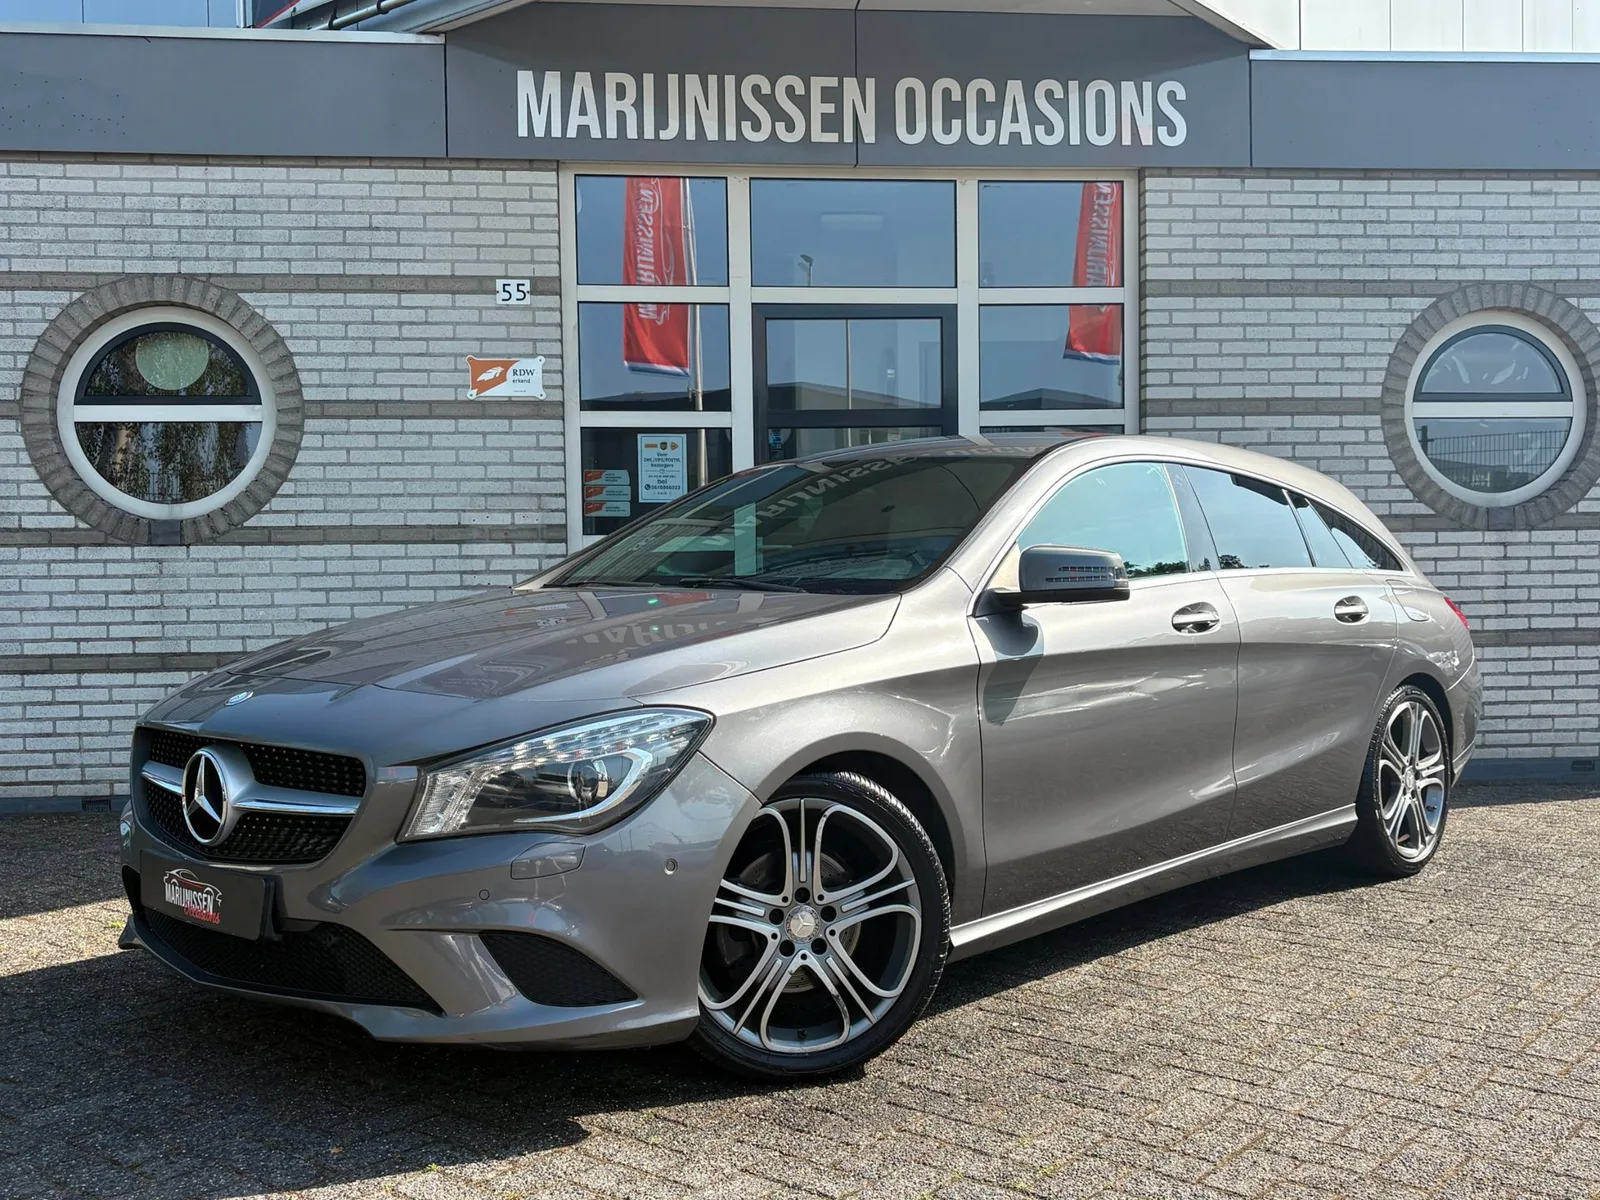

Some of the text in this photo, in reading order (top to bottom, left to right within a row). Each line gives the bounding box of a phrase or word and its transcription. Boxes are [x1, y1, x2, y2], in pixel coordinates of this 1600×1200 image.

[516, 70, 1188, 148] MARIJNISSEN OCCASIONS
[501, 283, 527, 302] 55
[512, 368, 536, 377] RDW
[165, 883, 214, 914] MARIJNISSEN
